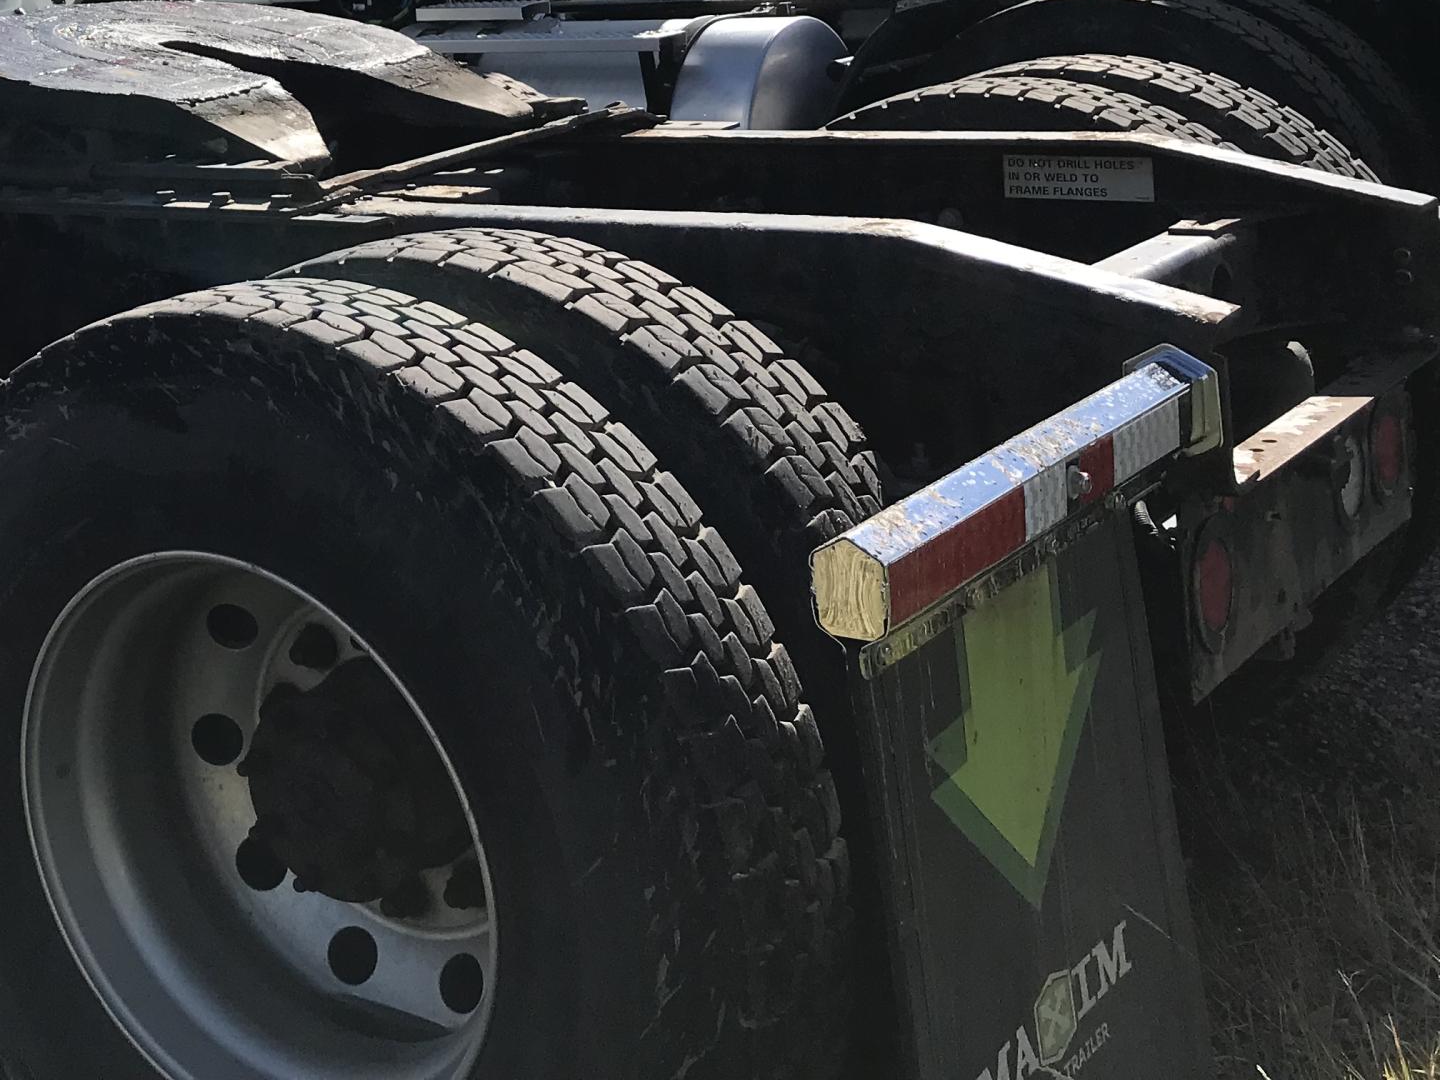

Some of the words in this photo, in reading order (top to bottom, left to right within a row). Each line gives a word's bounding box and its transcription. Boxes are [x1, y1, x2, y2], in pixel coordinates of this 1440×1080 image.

[1007, 158, 1025, 168] DO
[1028, 158, 1052, 169] NOT
[1057, 158, 1090, 169] DRILL
[1094, 159, 1135, 170] HOLES
[1008, 171, 1020, 181] IN
[1023, 172, 1041, 182] OR
[1044, 172, 1078, 183] WELD
[1082, 173, 1099, 183] TO
[1009, 185, 1049, 196] FRAME
[1053, 186, 1108, 197] FLANGES
[1063, 1022, 1111, 1078] TRAILER
